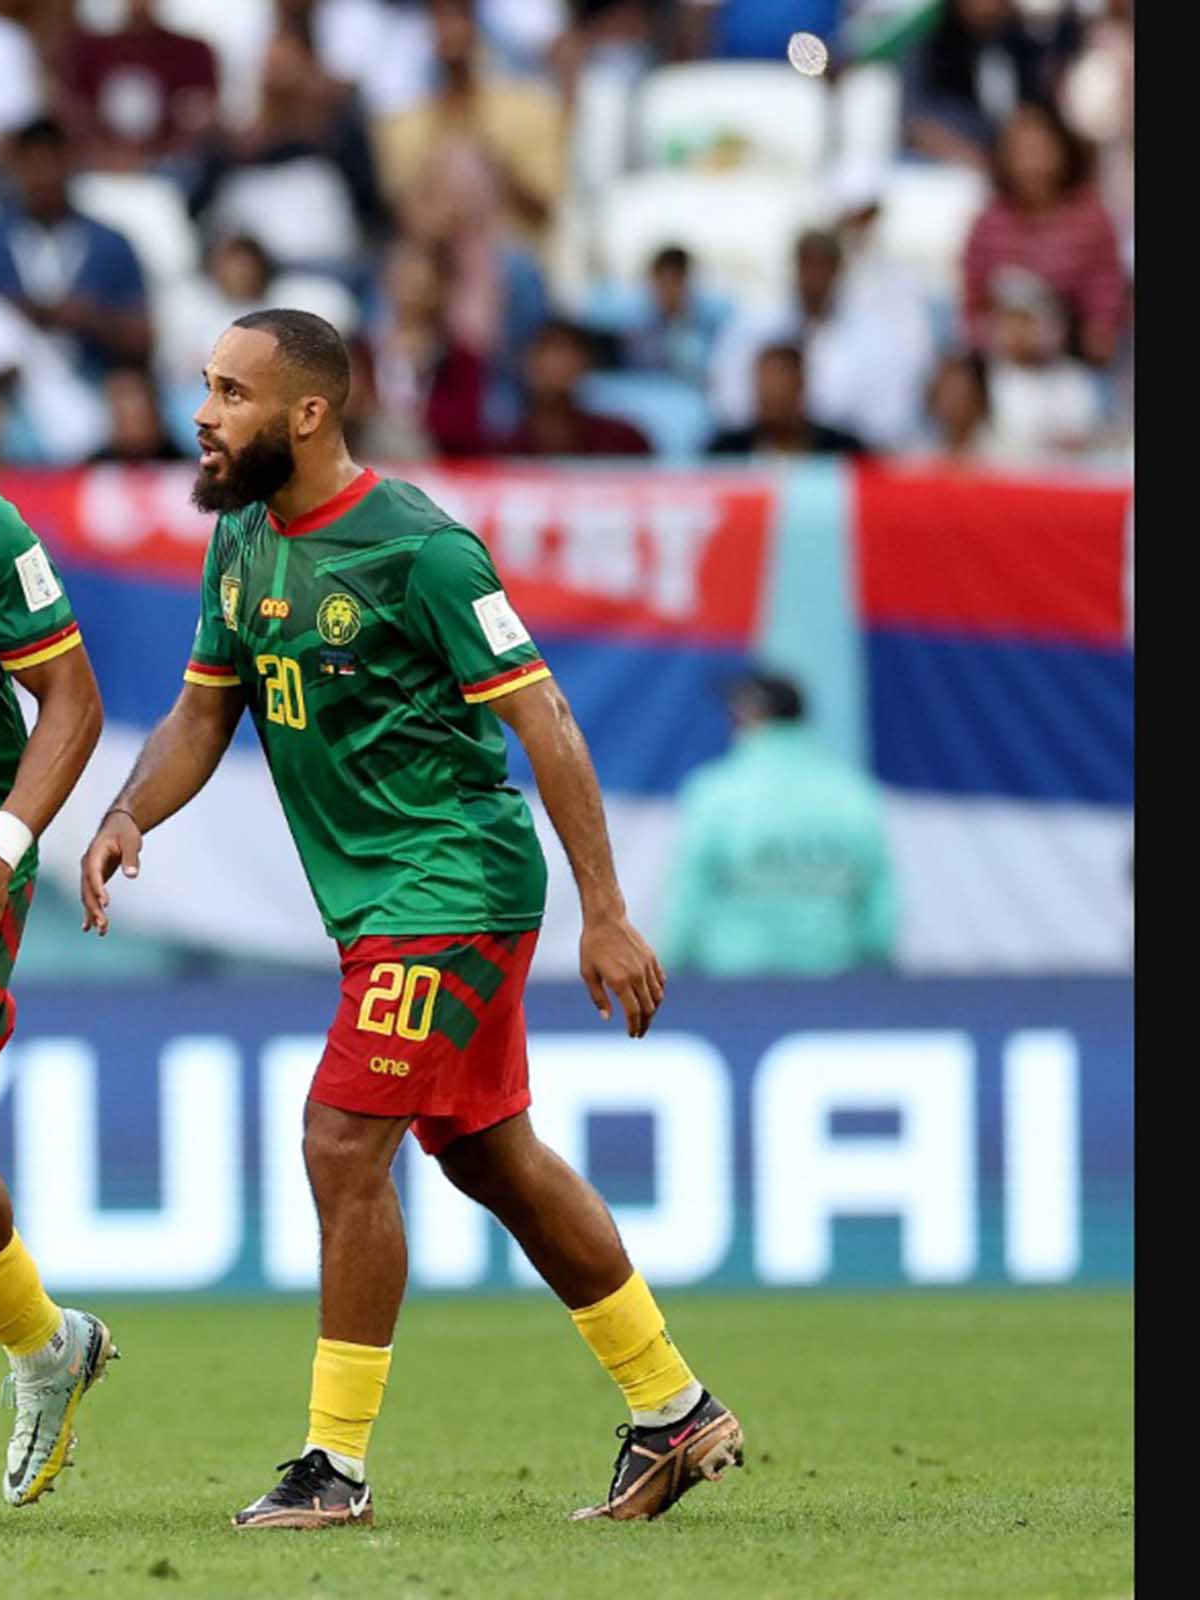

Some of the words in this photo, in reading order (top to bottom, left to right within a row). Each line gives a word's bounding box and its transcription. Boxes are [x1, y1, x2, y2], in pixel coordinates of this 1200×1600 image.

[261, 597, 291, 619] one
[255, 654, 308, 731] 20
[356, 962, 442, 1042] 20
[369, 1056, 410, 1077] one
